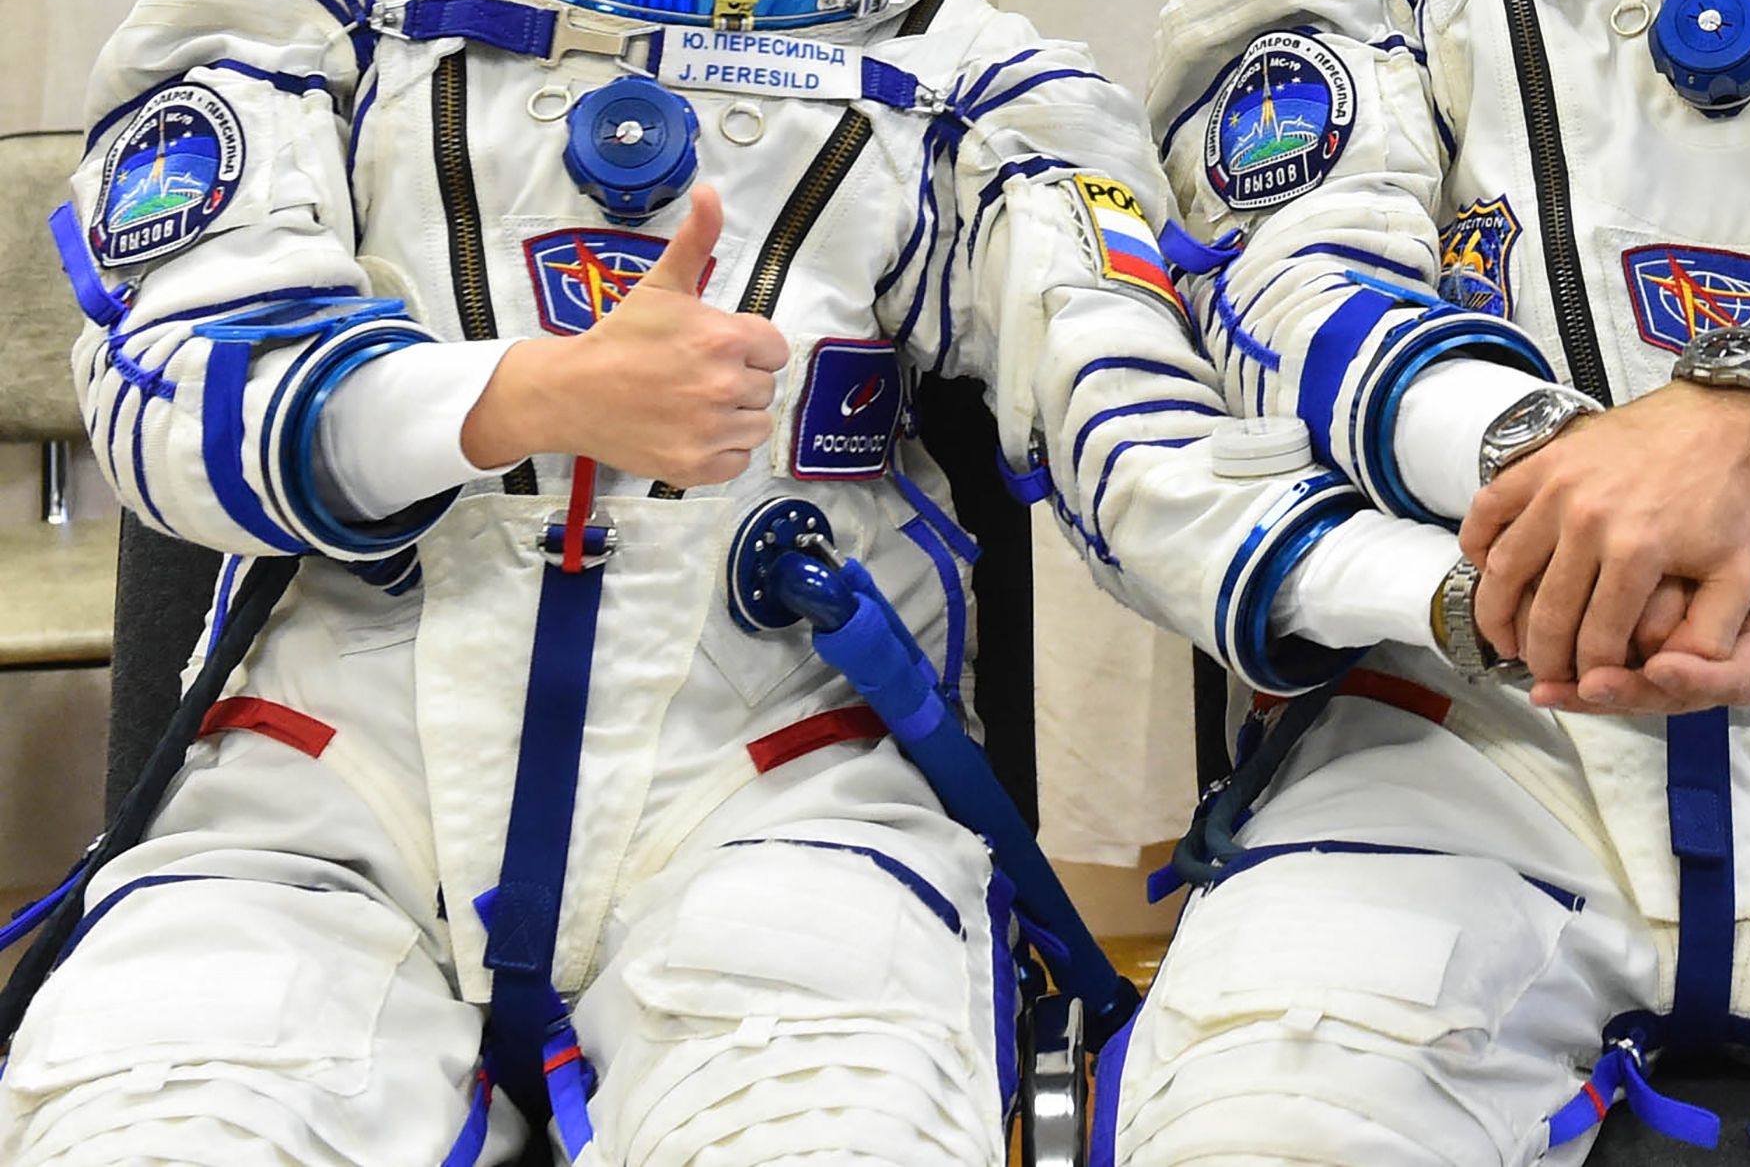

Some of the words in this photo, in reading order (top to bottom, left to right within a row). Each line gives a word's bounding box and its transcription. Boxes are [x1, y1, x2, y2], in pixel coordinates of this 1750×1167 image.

[683, 32, 709, 50] Ю.
[714, 33, 846, 66] ПЕРЕСИЛЬД
[678, 64, 697, 82] J.
[704, 64, 820, 90] PERESILD
[1314, 52, 1347, 120] ПЕРЕСИЛЬД
[1243, 164, 1298, 195] ВЫЗОВ
[119, 219, 175, 253] ВЫЗОВ
